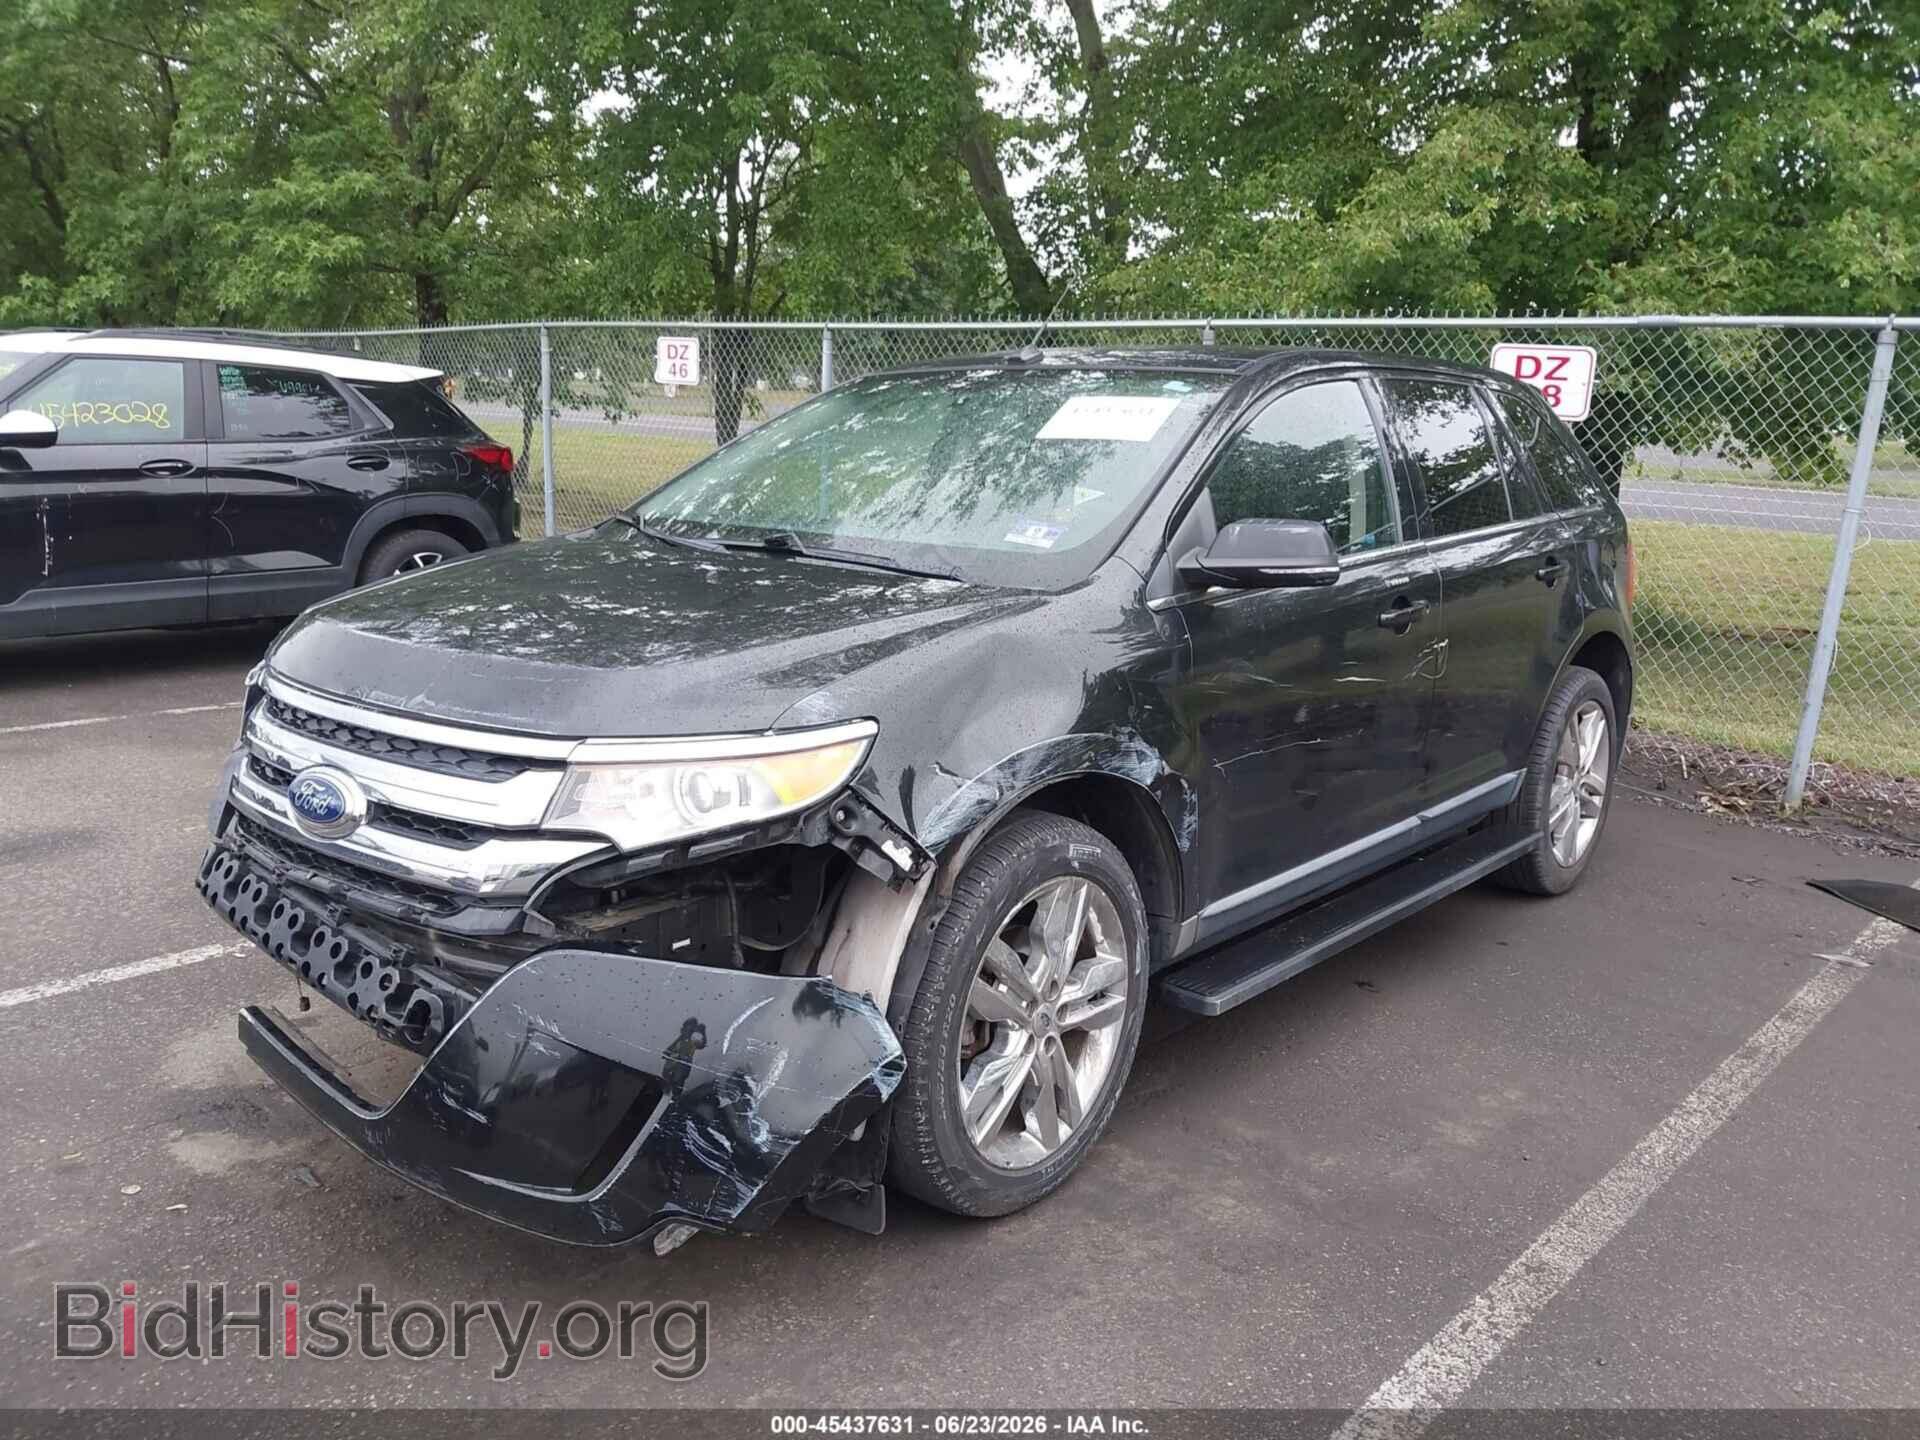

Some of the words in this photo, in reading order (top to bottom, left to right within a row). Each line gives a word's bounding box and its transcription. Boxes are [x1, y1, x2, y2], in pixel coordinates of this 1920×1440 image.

[667, 344, 689, 360] DZ
[668, 362, 688, 378] 46
[1514, 355, 1571, 381] DZ
[1541, 384, 1562, 408] 8
[294, 780, 333, 816] Ford
